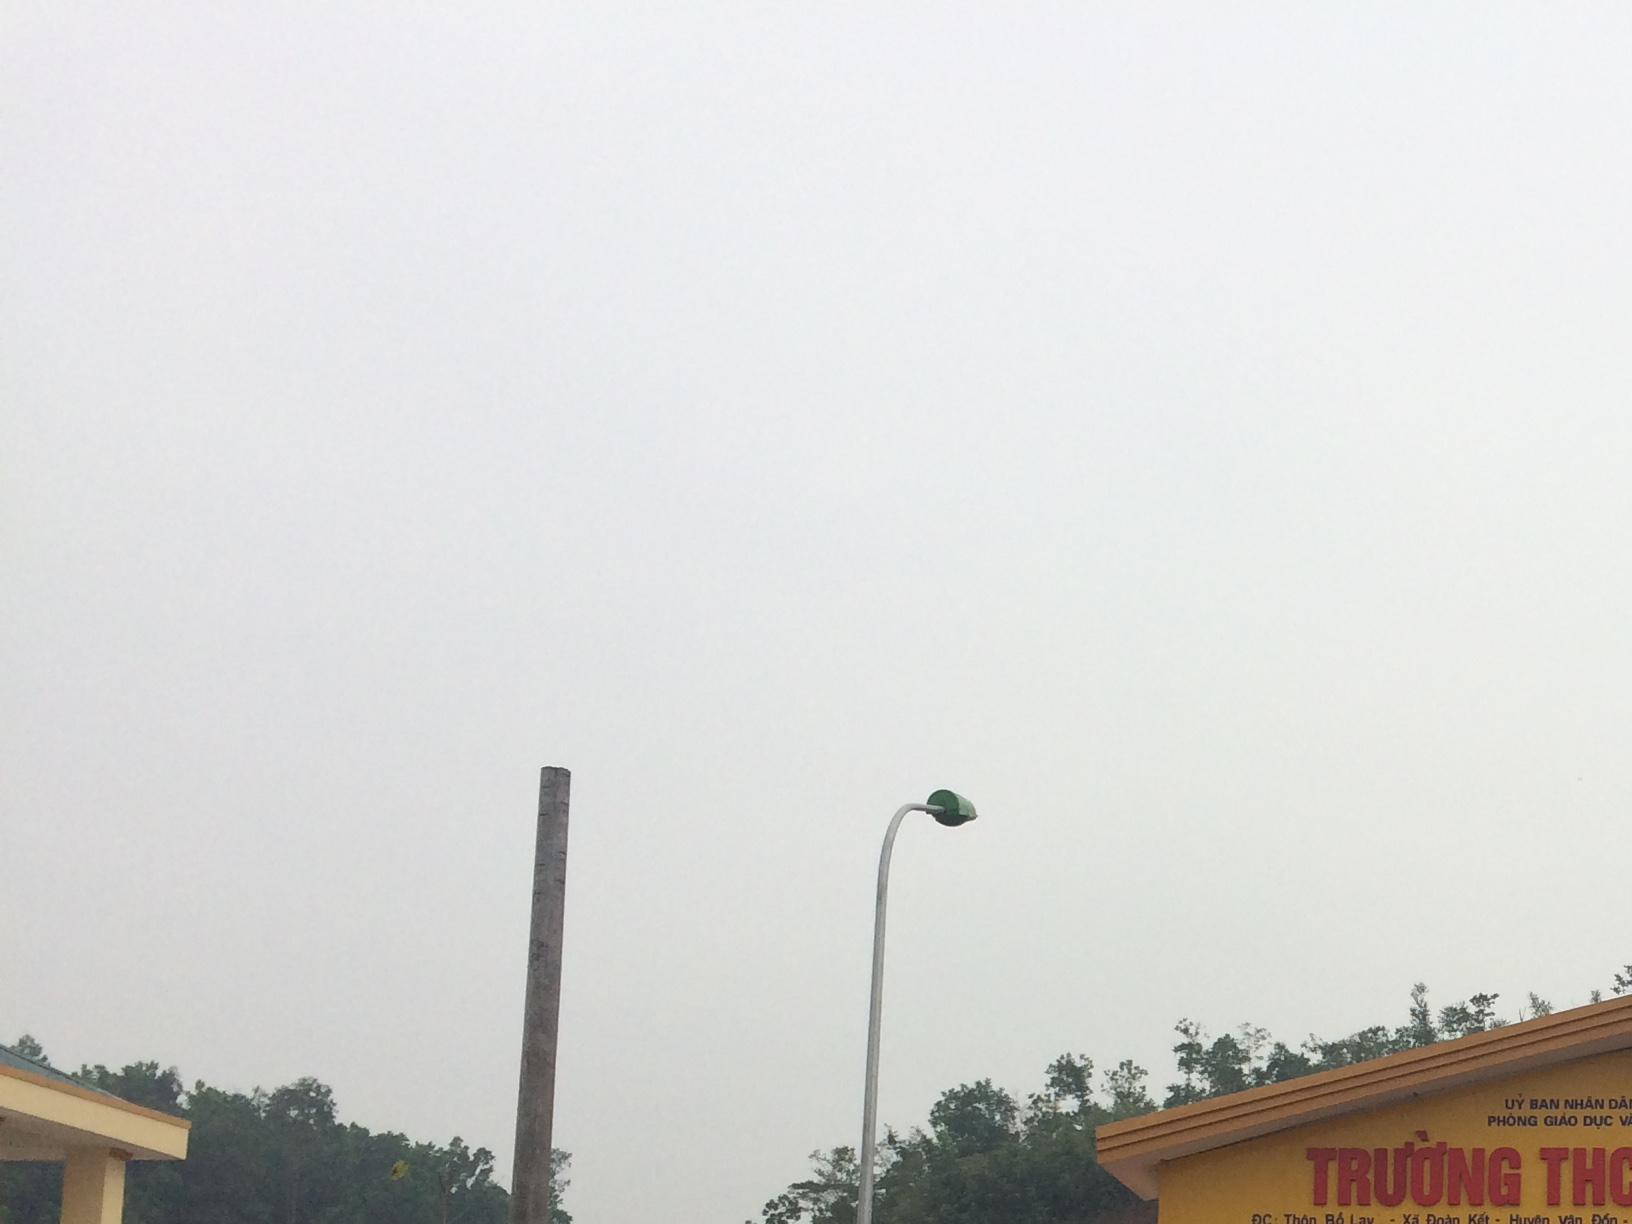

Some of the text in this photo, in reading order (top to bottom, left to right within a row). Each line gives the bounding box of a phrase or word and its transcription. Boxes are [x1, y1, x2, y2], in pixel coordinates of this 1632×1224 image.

[1529, 1099, 1559, 1109] BAN
[1564, 1096, 1604, 1109] NHÂN
[1487, 1113, 1538, 1126] PHÒNG
[1544, 1113, 1578, 1126] GIÁO
[1583, 1115, 1613, 1129] DỤC
[1306, 1130, 1522, 1207] TRƯỜNG
